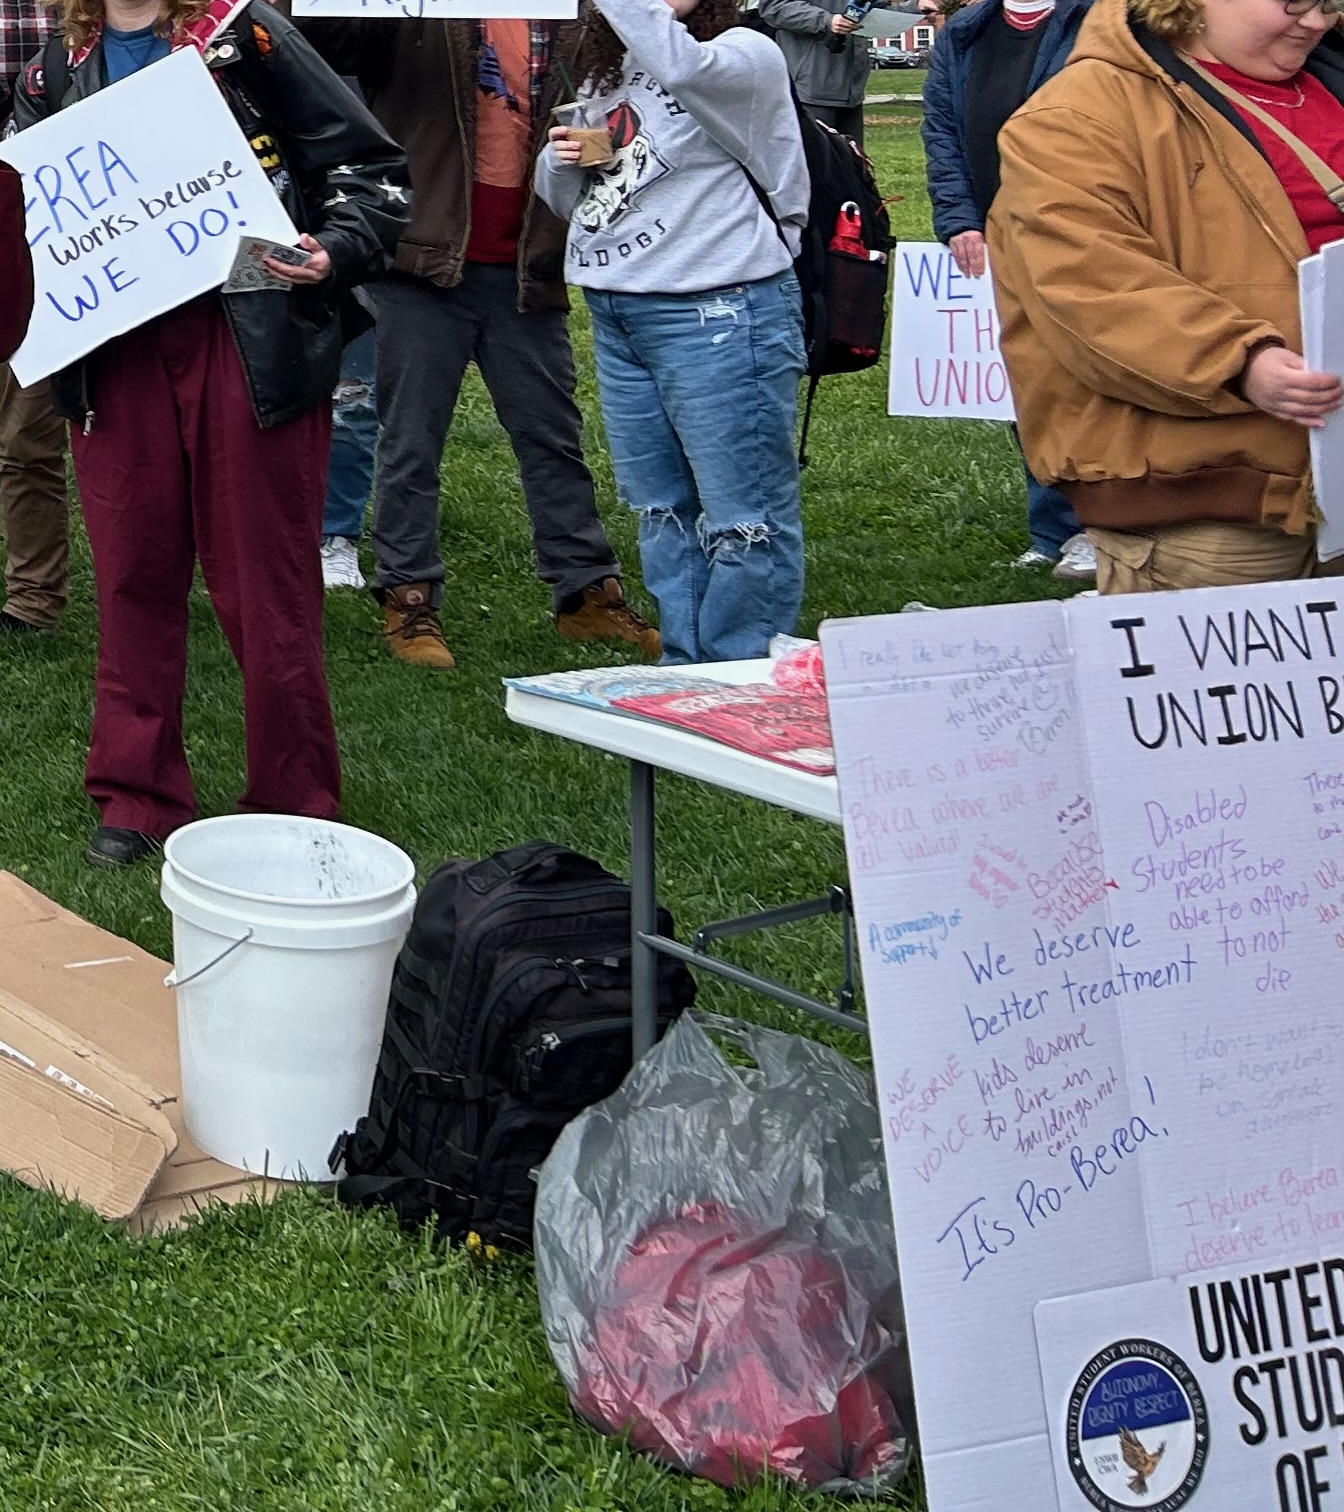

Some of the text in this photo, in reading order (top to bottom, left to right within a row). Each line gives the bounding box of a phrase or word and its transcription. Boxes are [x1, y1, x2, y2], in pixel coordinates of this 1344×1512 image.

[138, 160, 243, 220] because
[45, 190, 247, 322] WE DO!
[903, 252, 973, 301] WE
[1111, 601, 1339, 678] I WANT
[1126, 681, 1306, 750] UNION
[1144, 783, 1248, 849] Disabled
[1175, 855, 1286, 902] need to be
[1169, 904, 1212, 931] able
[1215, 897, 1244, 925] to
[1215, 925, 1247, 967] to
[1253, 914, 1293, 955] not
[962, 942, 1015, 985] We
[1034, 922, 1142, 966] deserve
[1256, 960, 1293, 993] die
[964, 943, 1199, 1045] better treatment
[975, 1058, 1019, 1106] kids
[1060, 1061, 1094, 1093] in
[913, 1113, 974, 1184] VOICE
[1206, 1185, 1272, 1223] believe
[936, 1196, 1015, 1282] It's
[1185, 1224, 1269, 1274] deserve
[1188, 1257, 1344, 1364] UNITED
[1079, 1348, 1118, 1396] STUDENT
[1119, 1343, 1175, 1367] WORKERS
[1275, 1444, 1332, 1512] OF
